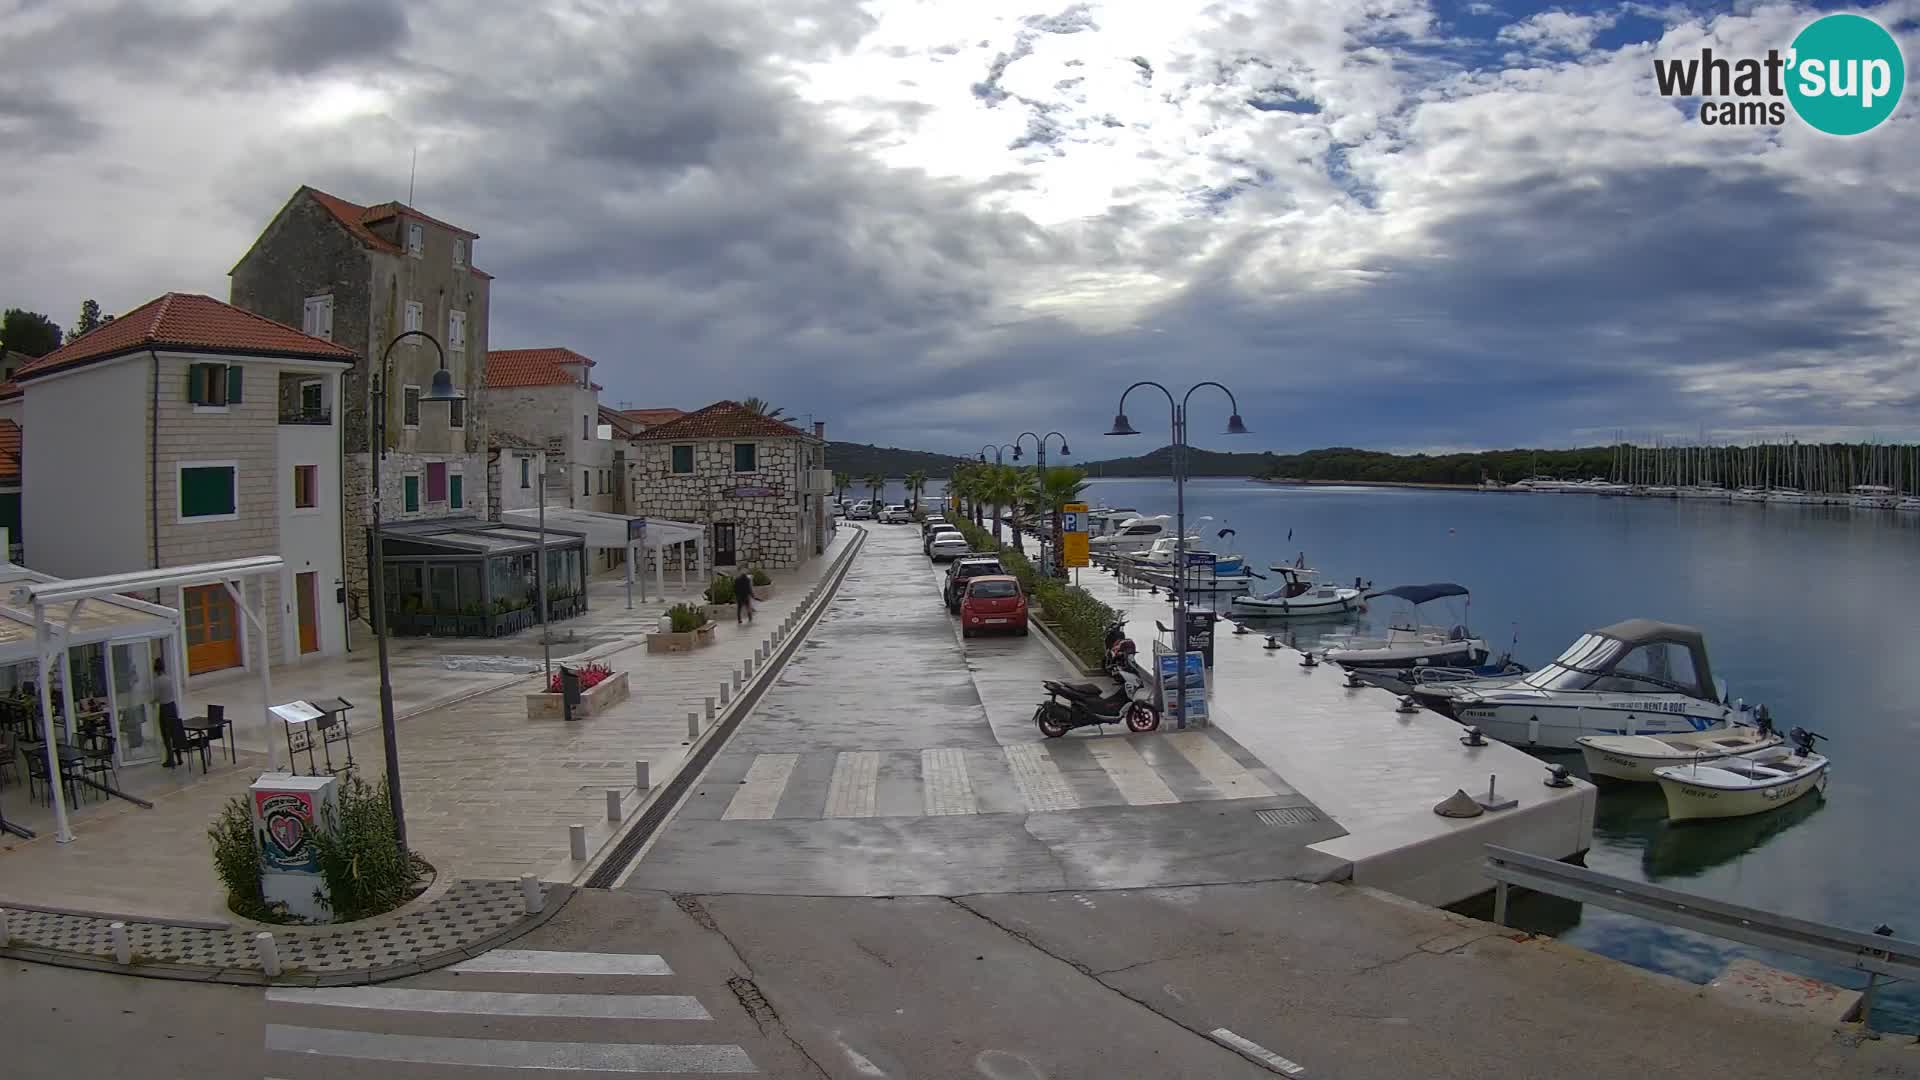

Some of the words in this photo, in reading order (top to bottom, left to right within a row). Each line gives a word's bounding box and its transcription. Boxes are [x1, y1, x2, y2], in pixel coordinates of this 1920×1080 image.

[1065, 514, 1076, 530] P
[1643, 702, 1662, 711] RENT
[1669, 702, 1687, 713] BOAT
